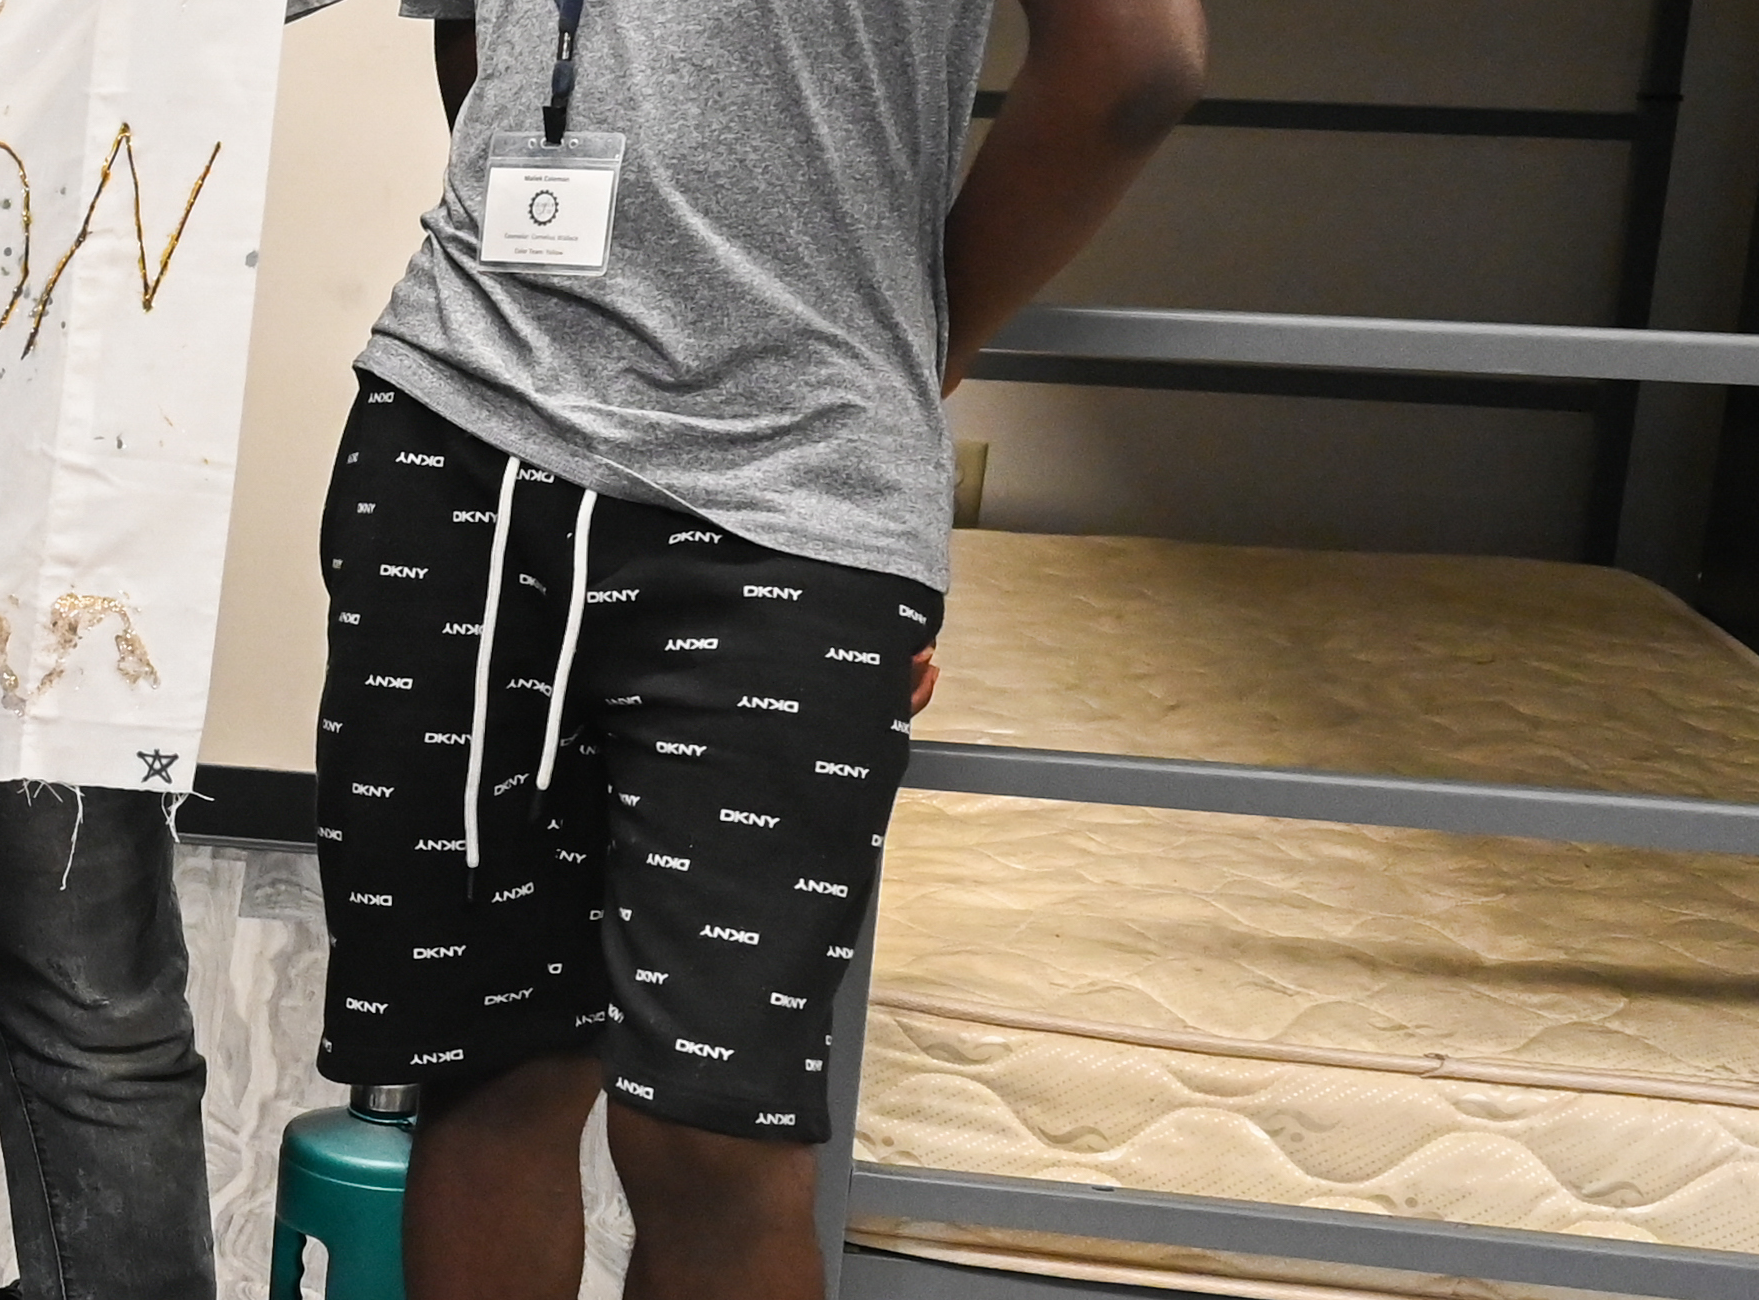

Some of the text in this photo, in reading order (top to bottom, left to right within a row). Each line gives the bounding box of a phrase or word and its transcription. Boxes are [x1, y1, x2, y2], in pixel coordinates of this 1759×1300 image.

[394, 451, 445, 468] DKNY
[515, 467, 557, 485] DKN
[668, 530, 723, 545] DKNY
[379, 563, 429, 580] DKNY
[586, 588, 640, 604] DKNY
[742, 584, 804, 602] DKNY
[664, 637, 719, 652] DKNY
[824, 646, 881, 666] DKNY
[364, 674, 414, 690] DKNY
[736, 695, 800, 714] DKNY
[655, 740, 708, 757] DKNY
[814, 760, 870, 780] DKNY
[351, 782, 395, 798] DKNY
[493, 773, 530, 797] DKNY
[719, 808, 781, 829] DKNY
[645, 852, 691, 872] DKNY
[491, 881, 535, 904] DKNY
[793, 877, 849, 899] DKNY
[349, 891, 393, 907] DKNY
[699, 924, 760, 946] DKNY
[412, 944, 467, 960] DKNY
[484, 987, 534, 1007] DKNY
[769, 991, 808, 1011] DKNY
[345, 997, 389, 1016] DKNY
[409, 1048, 464, 1066] DKNY
[674, 1038, 736, 1062] DKNY
[615, 1076, 655, 1102] DKNY
[755, 1112, 796, 1127] DKNY
